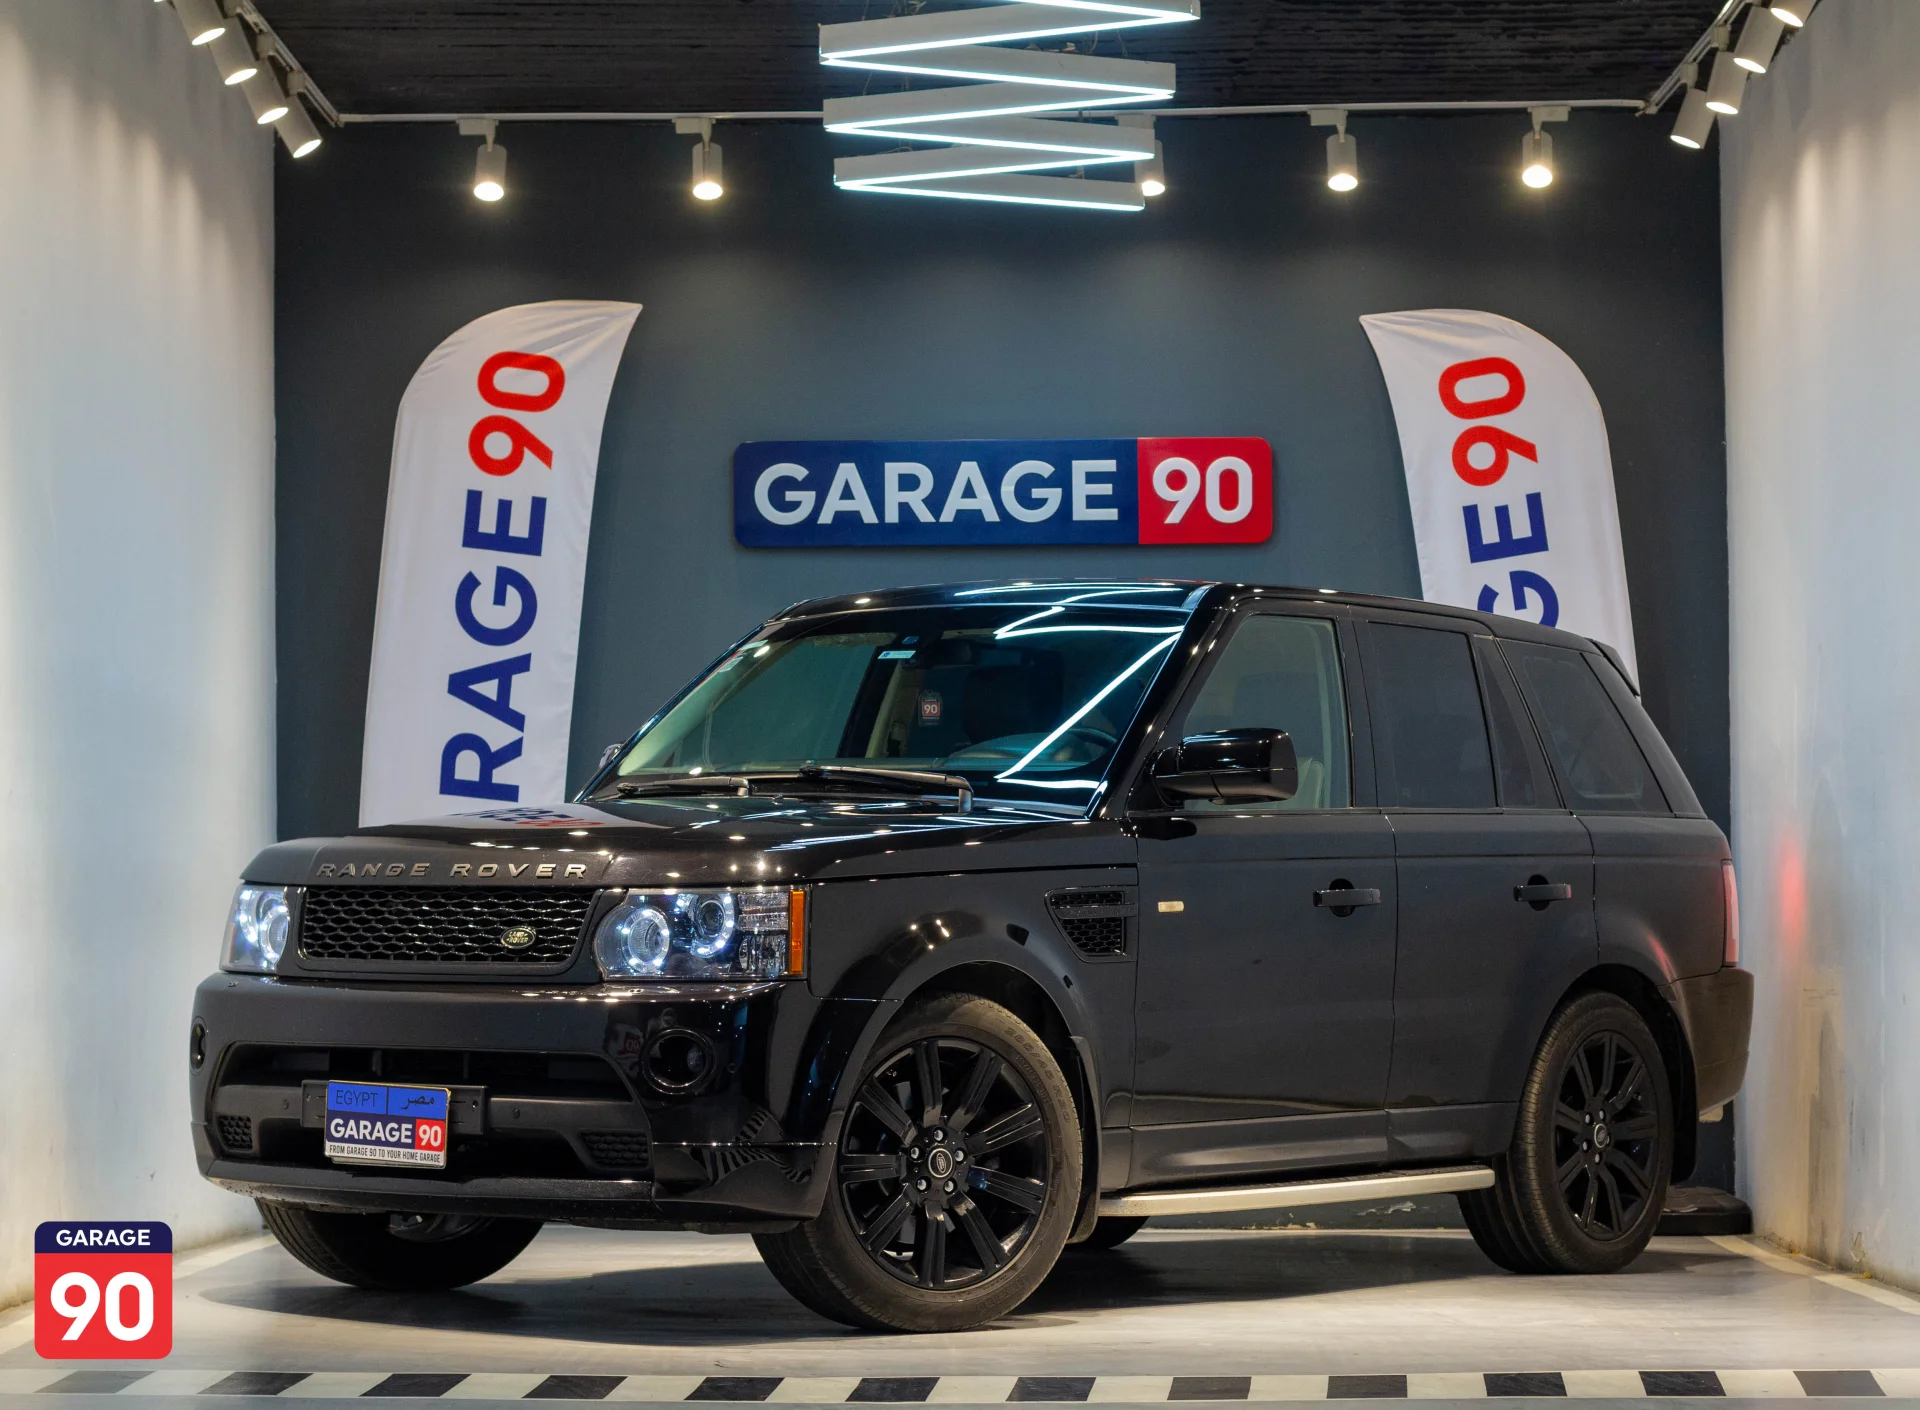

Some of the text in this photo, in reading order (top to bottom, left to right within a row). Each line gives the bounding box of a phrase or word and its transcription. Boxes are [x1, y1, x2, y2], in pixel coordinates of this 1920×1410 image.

[468, 350, 566, 477] 90
[1438, 356, 1538, 487] 90
[753, 455, 1253, 526] GARAGE 90
[924, 704, 938, 714] 90
[316, 862, 587, 879] RANGE ROVER
[335, 1089, 378, 1107] EGYPT
[401, 1095, 434, 1110] مصر
[330, 1118, 441, 1147] GARAGE 90
[329, 1144, 345, 1154] FROM
[347, 1146, 367, 1156] GARAGE
[378, 1149, 385, 1157] TO
[387, 1150, 401, 1159] YOUR
[402, 1152, 418, 1160] HOME
[420, 1153, 440, 1163] GARAGE
